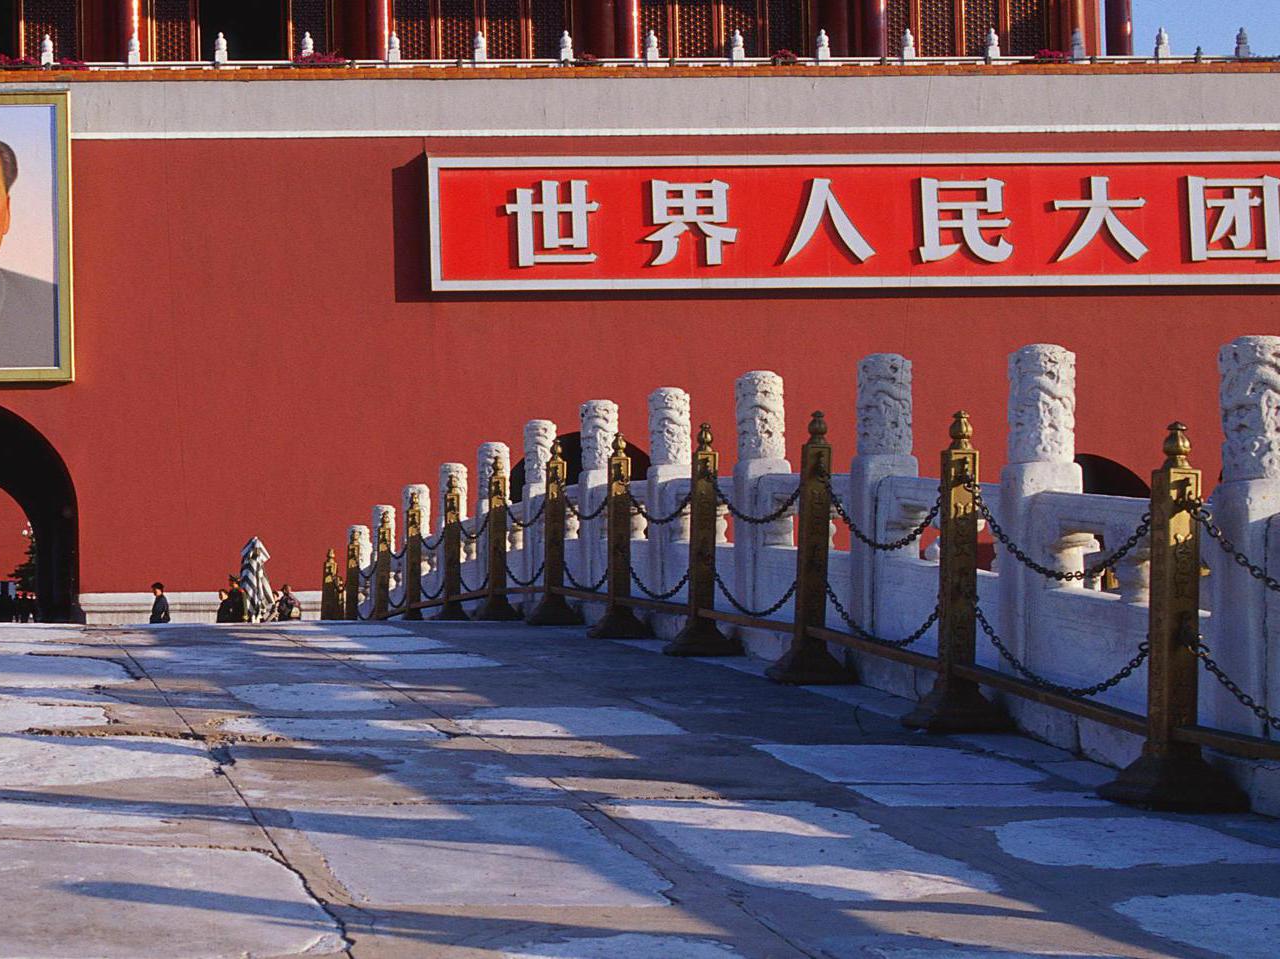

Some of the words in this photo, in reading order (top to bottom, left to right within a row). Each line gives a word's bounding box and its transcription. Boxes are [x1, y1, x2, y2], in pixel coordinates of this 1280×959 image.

[505, 174, 1280, 266] 世界人民大团
